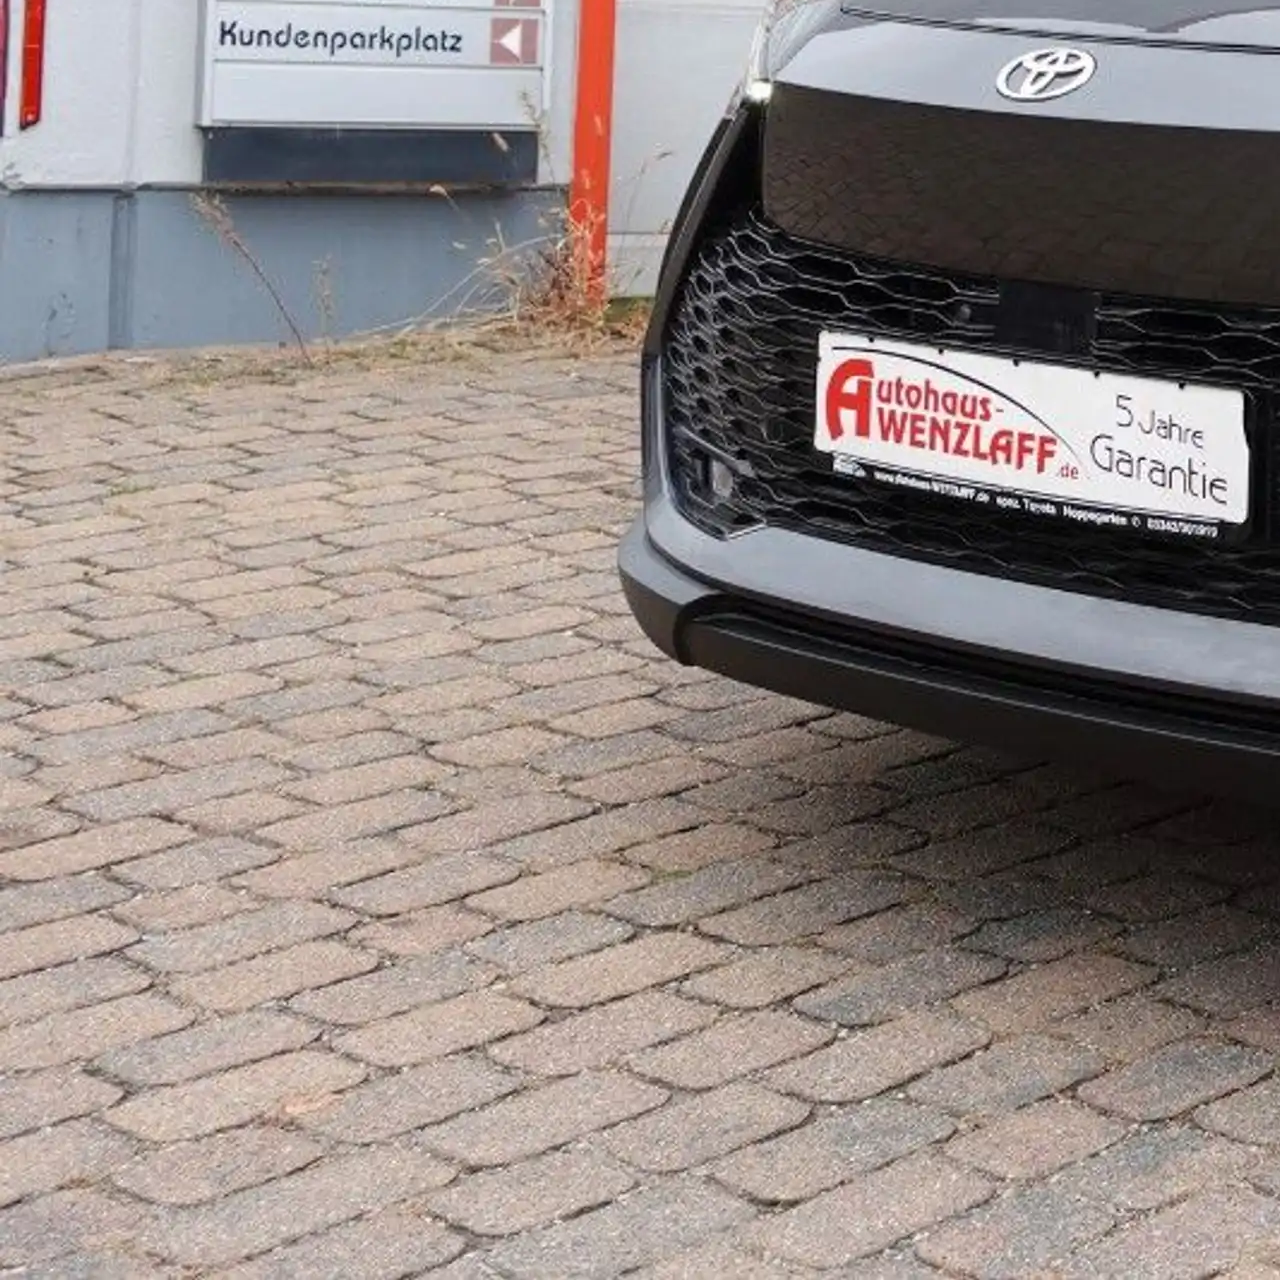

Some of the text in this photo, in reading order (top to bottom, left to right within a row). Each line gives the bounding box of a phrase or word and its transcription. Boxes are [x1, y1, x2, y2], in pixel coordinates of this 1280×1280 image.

[218, 20, 463, 58] Kundenparkplatz
[1115, 394, 1204, 449] 5 Jahre
[1090, 433, 1228, 506] Garantie
